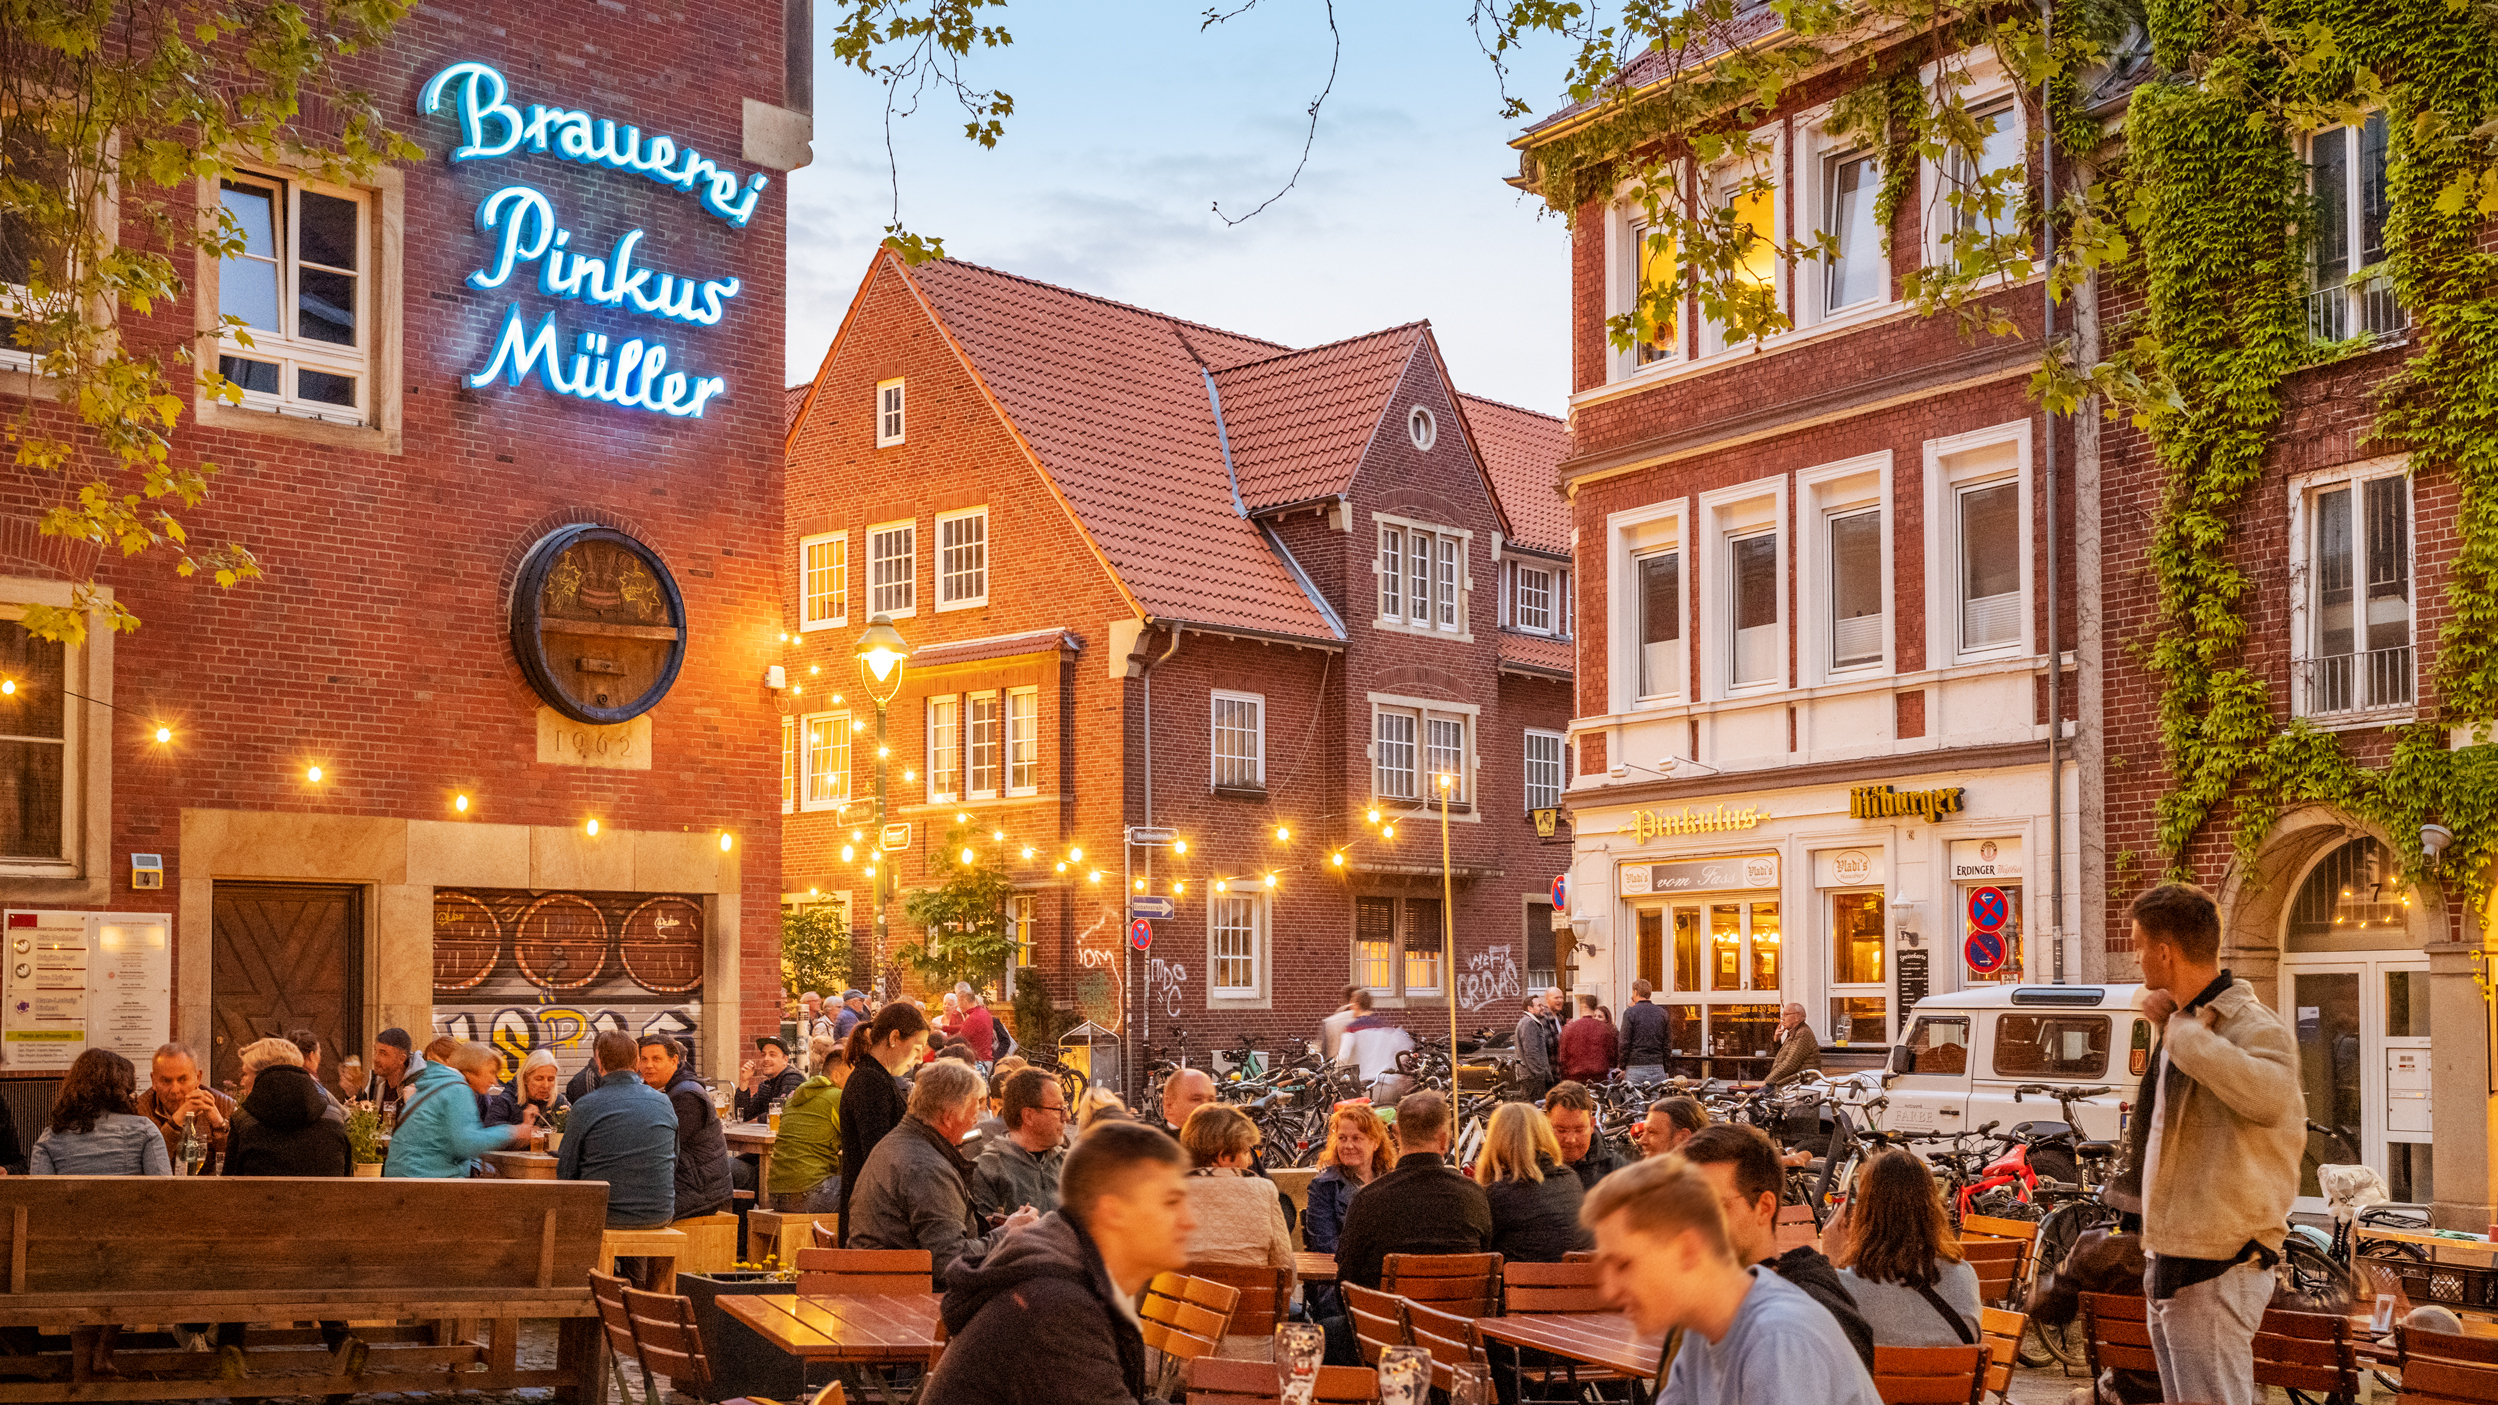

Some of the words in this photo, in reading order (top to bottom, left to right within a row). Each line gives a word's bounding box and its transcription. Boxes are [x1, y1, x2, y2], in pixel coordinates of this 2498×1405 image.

[418, 61, 769, 229] Brauerei
[466, 185, 740, 327] Pinkus
[462, 301, 725, 418] Müller
[556, 730, 632, 757] 1962
[1629, 803, 1758, 844] Pinkulus
[1748, 865, 1773, 877] Vladi's
[1836, 859, 1868, 873] Vladi's
[1957, 865, 1996, 876] ERDINGER
[143, 873, 150, 886] 4
[1625, 872, 1649, 884] Vladi's
[1657, 876, 1691, 888] vom
[1697, 865, 1738, 886] Fass
[2370, 883, 2382, 902] 7
[1895, 1110, 1933, 1123] FARBE
